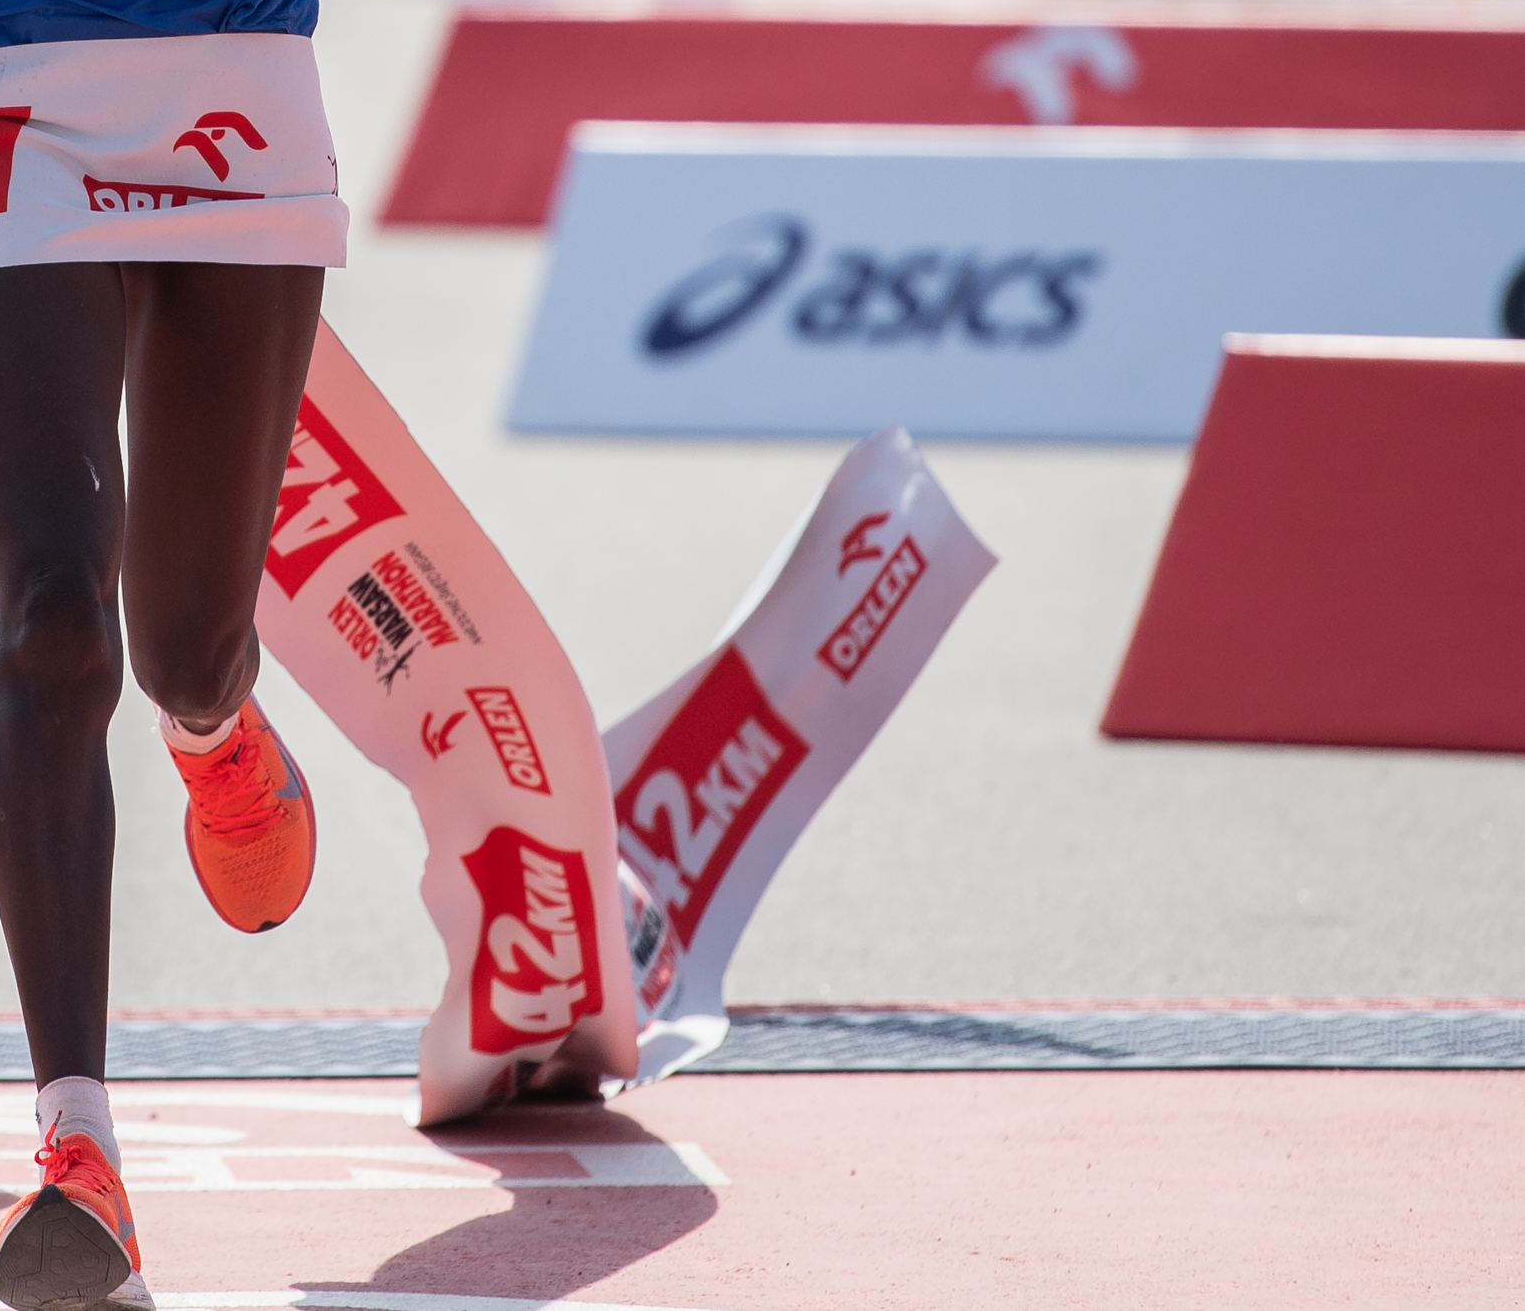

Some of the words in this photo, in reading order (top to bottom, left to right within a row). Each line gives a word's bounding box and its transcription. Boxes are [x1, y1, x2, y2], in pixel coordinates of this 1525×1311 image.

[327, 594, 377, 661] ORLEN
[347, 571, 414, 650] WARSAW
[371, 550, 460, 648] MARATHON
[831, 549, 921, 675] ORLEN
[475, 690, 542, 790] ORLEN
[488, 845, 586, 1034] 42KM
